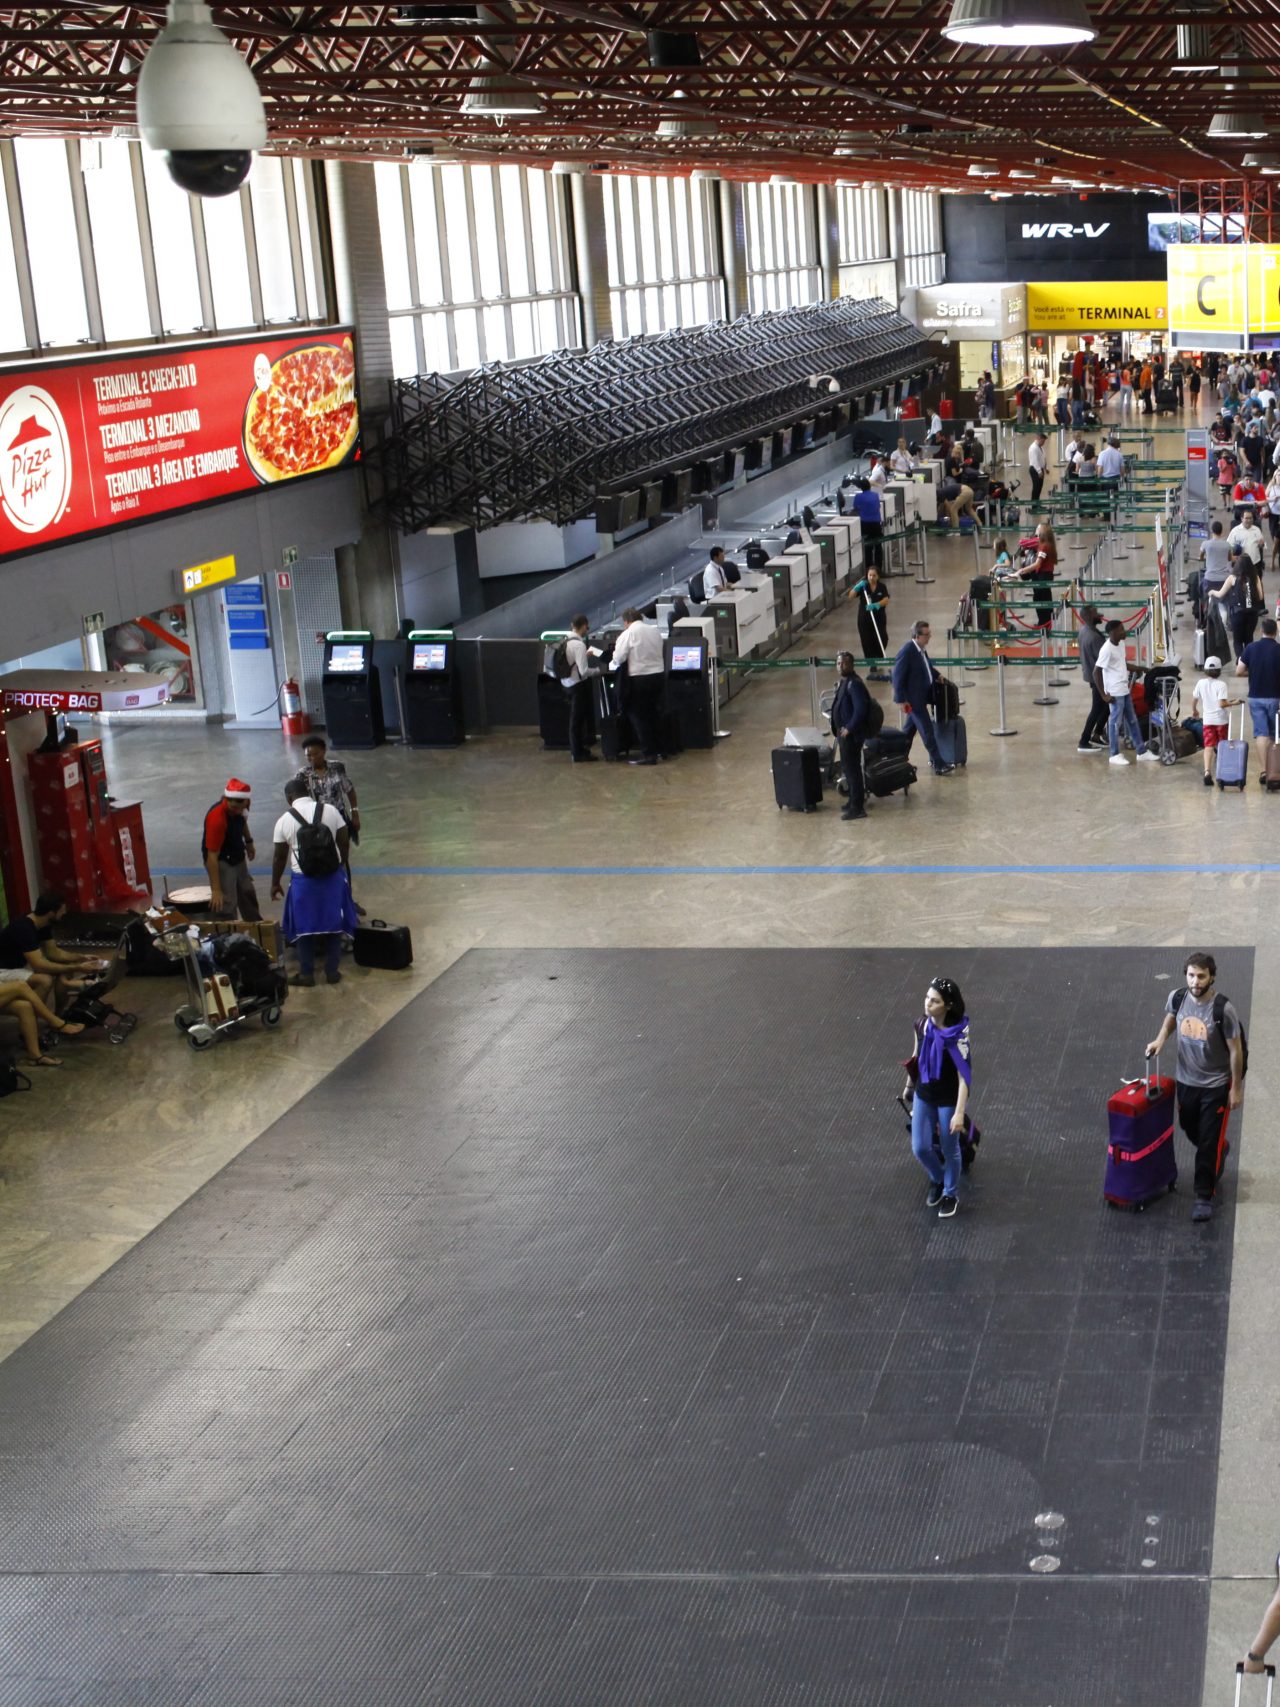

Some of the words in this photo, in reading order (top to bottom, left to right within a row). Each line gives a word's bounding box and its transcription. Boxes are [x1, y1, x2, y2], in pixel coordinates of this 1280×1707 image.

[1022, 223, 1110, 238] WR-V
[936, 302, 982, 316] Safra
[1078, 308, 1150, 319] TERMINAL
[1156, 308, 1164, 318] 2
[1197, 275, 1216, 316] C
[93, 372, 142, 401] TERMINAL
[142, 372, 150, 394] 2
[149, 364, 190, 392] CHECK-IN
[190, 364, 198, 386] D
[99, 419, 148, 449] TERMINAL
[148, 417, 154, 440] 3
[155, 408, 200, 438] MEZANINO
[12, 447, 52, 488] Pizza
[130, 446, 152, 459] Embarque
[22, 470, 52, 507] Hut
[105, 468, 154, 498] TERMINAL
[154, 467, 161, 487] 3
[161, 458, 182, 485] ÁREA
[184, 456, 196, 480] DE
[196, 446, 240, 476] EMBARQUE
[68, 694, 98, 708] BAG
